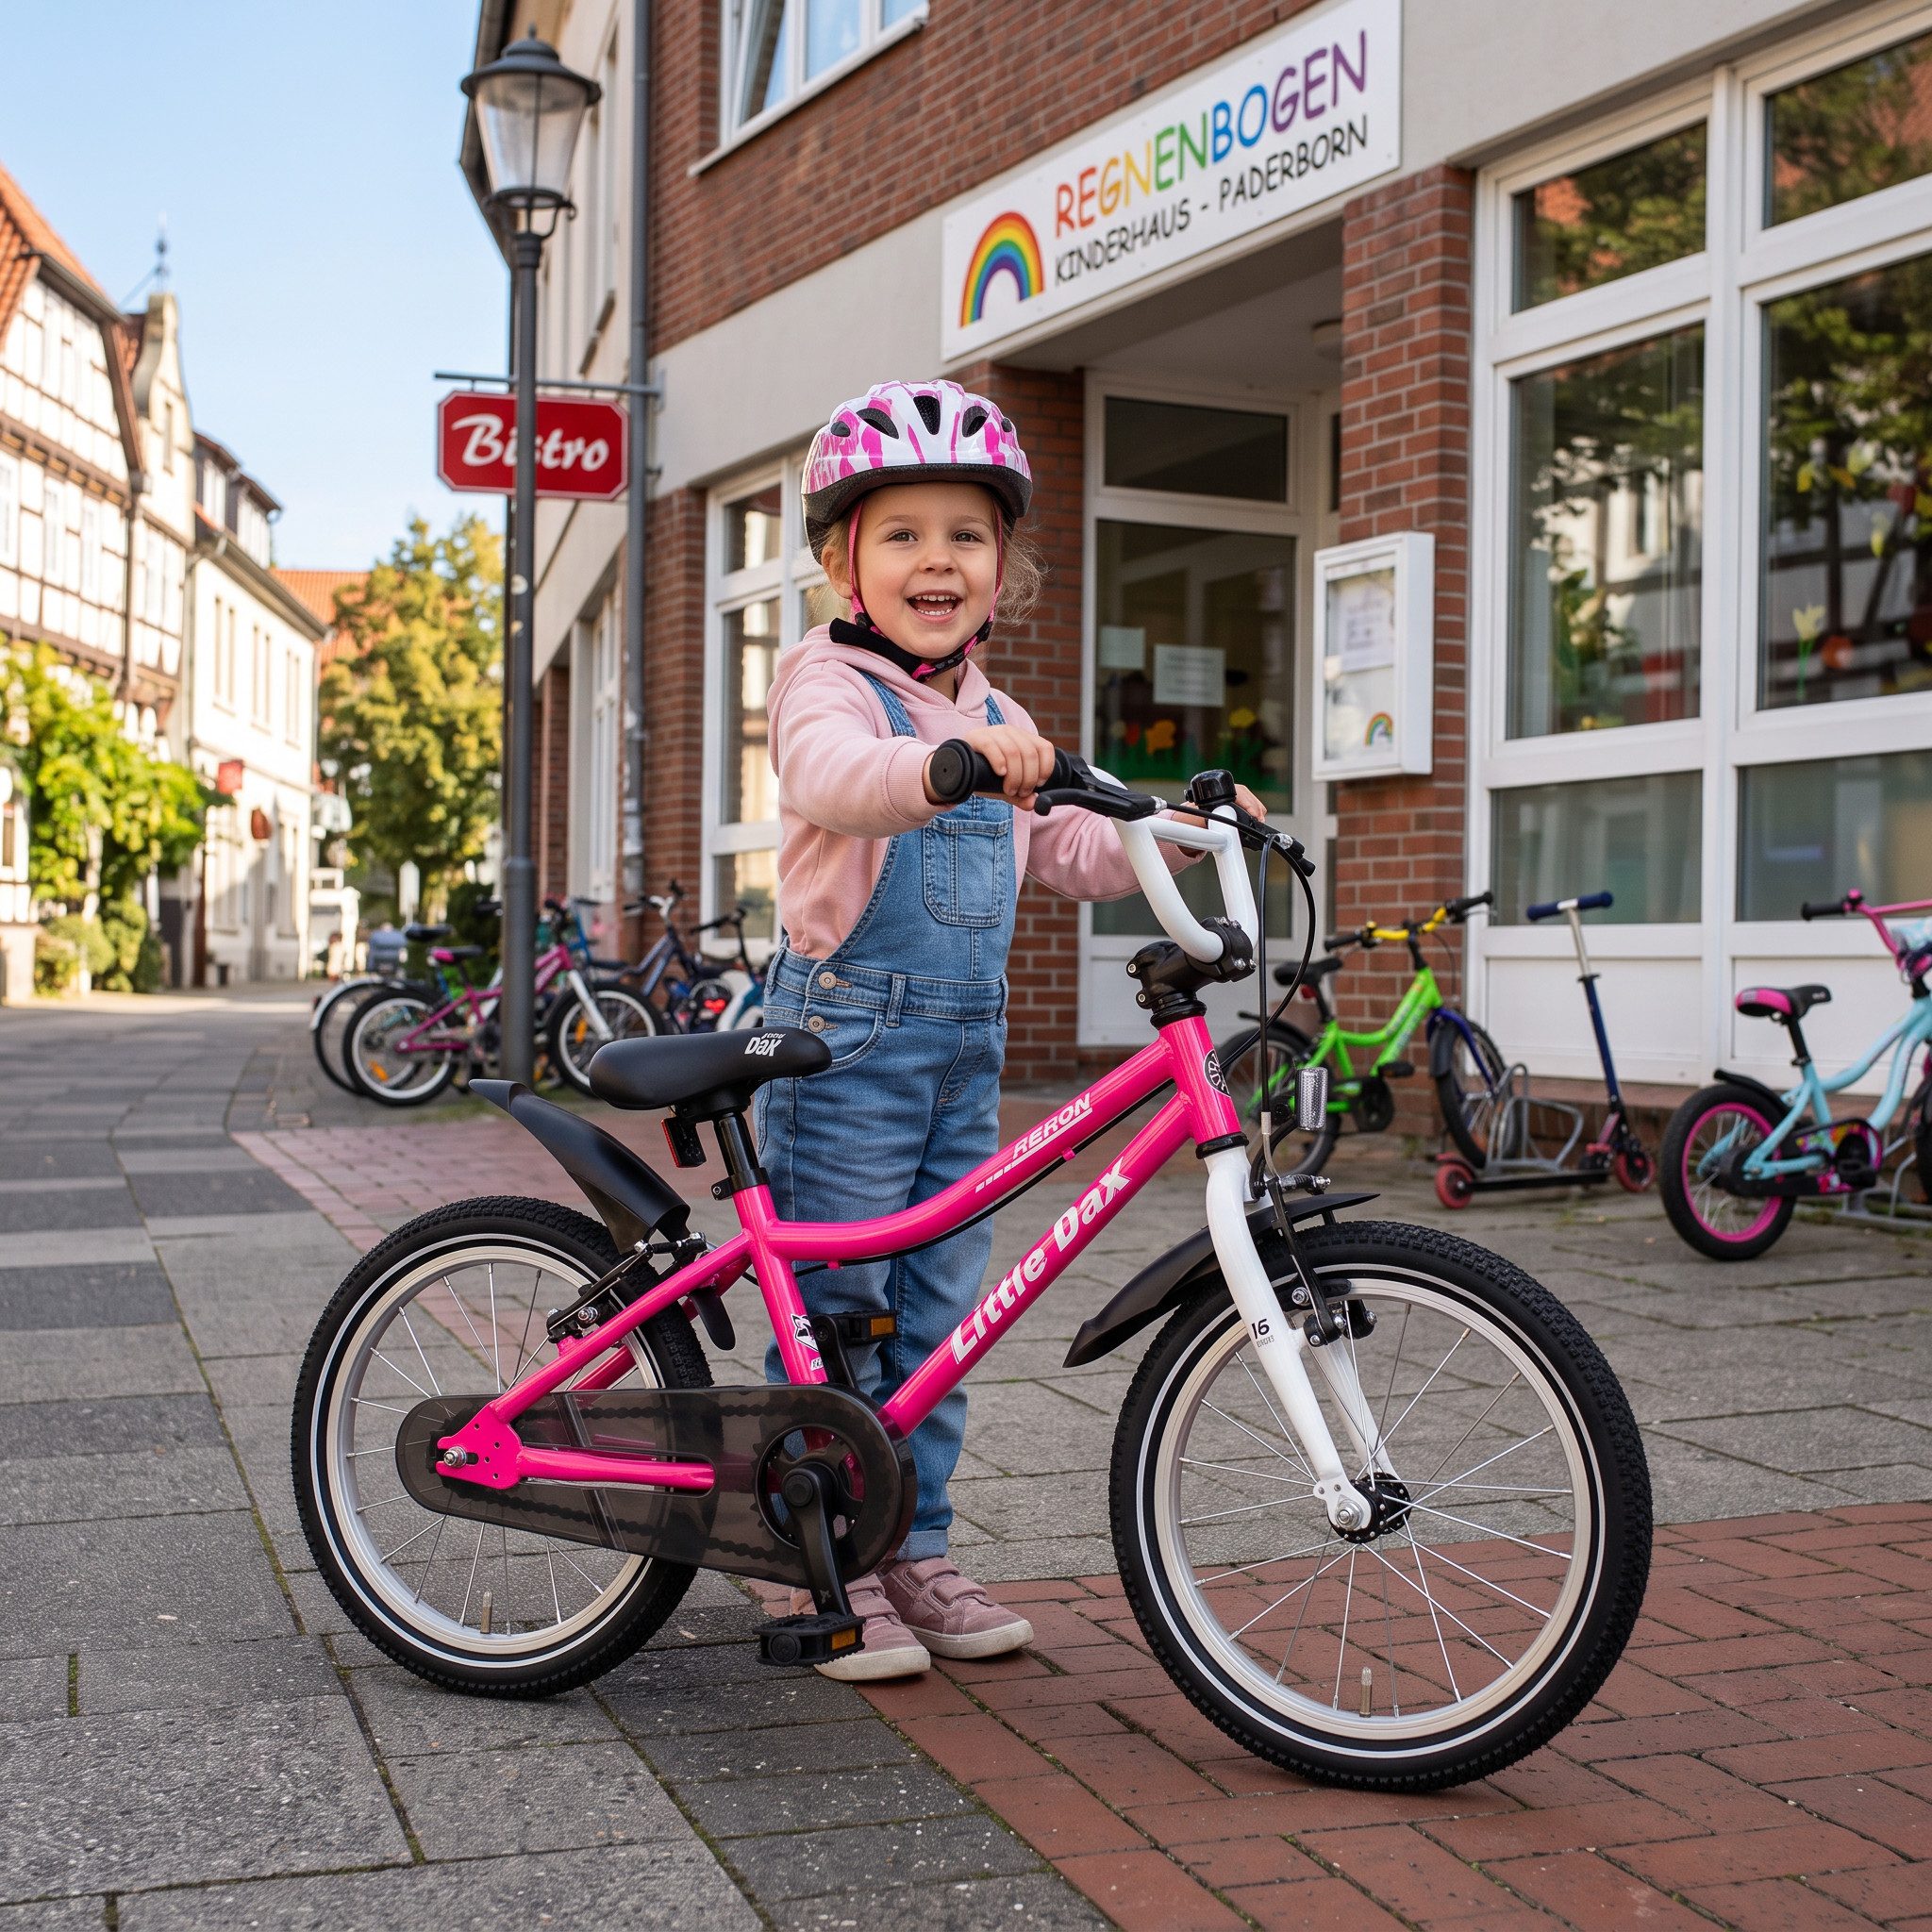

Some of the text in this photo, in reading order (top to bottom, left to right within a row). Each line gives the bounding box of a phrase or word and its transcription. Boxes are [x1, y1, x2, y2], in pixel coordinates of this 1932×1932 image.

[1056, 30, 1367, 238] REGNENBOGEN
[1056, 198, 1191, 286] KINDERHAUS
[1219, 114, 1368, 212] PADERBORN
[951, 1157, 1132, 1364] Little Dax
[1251, 1318, 1270, 1340] 16
